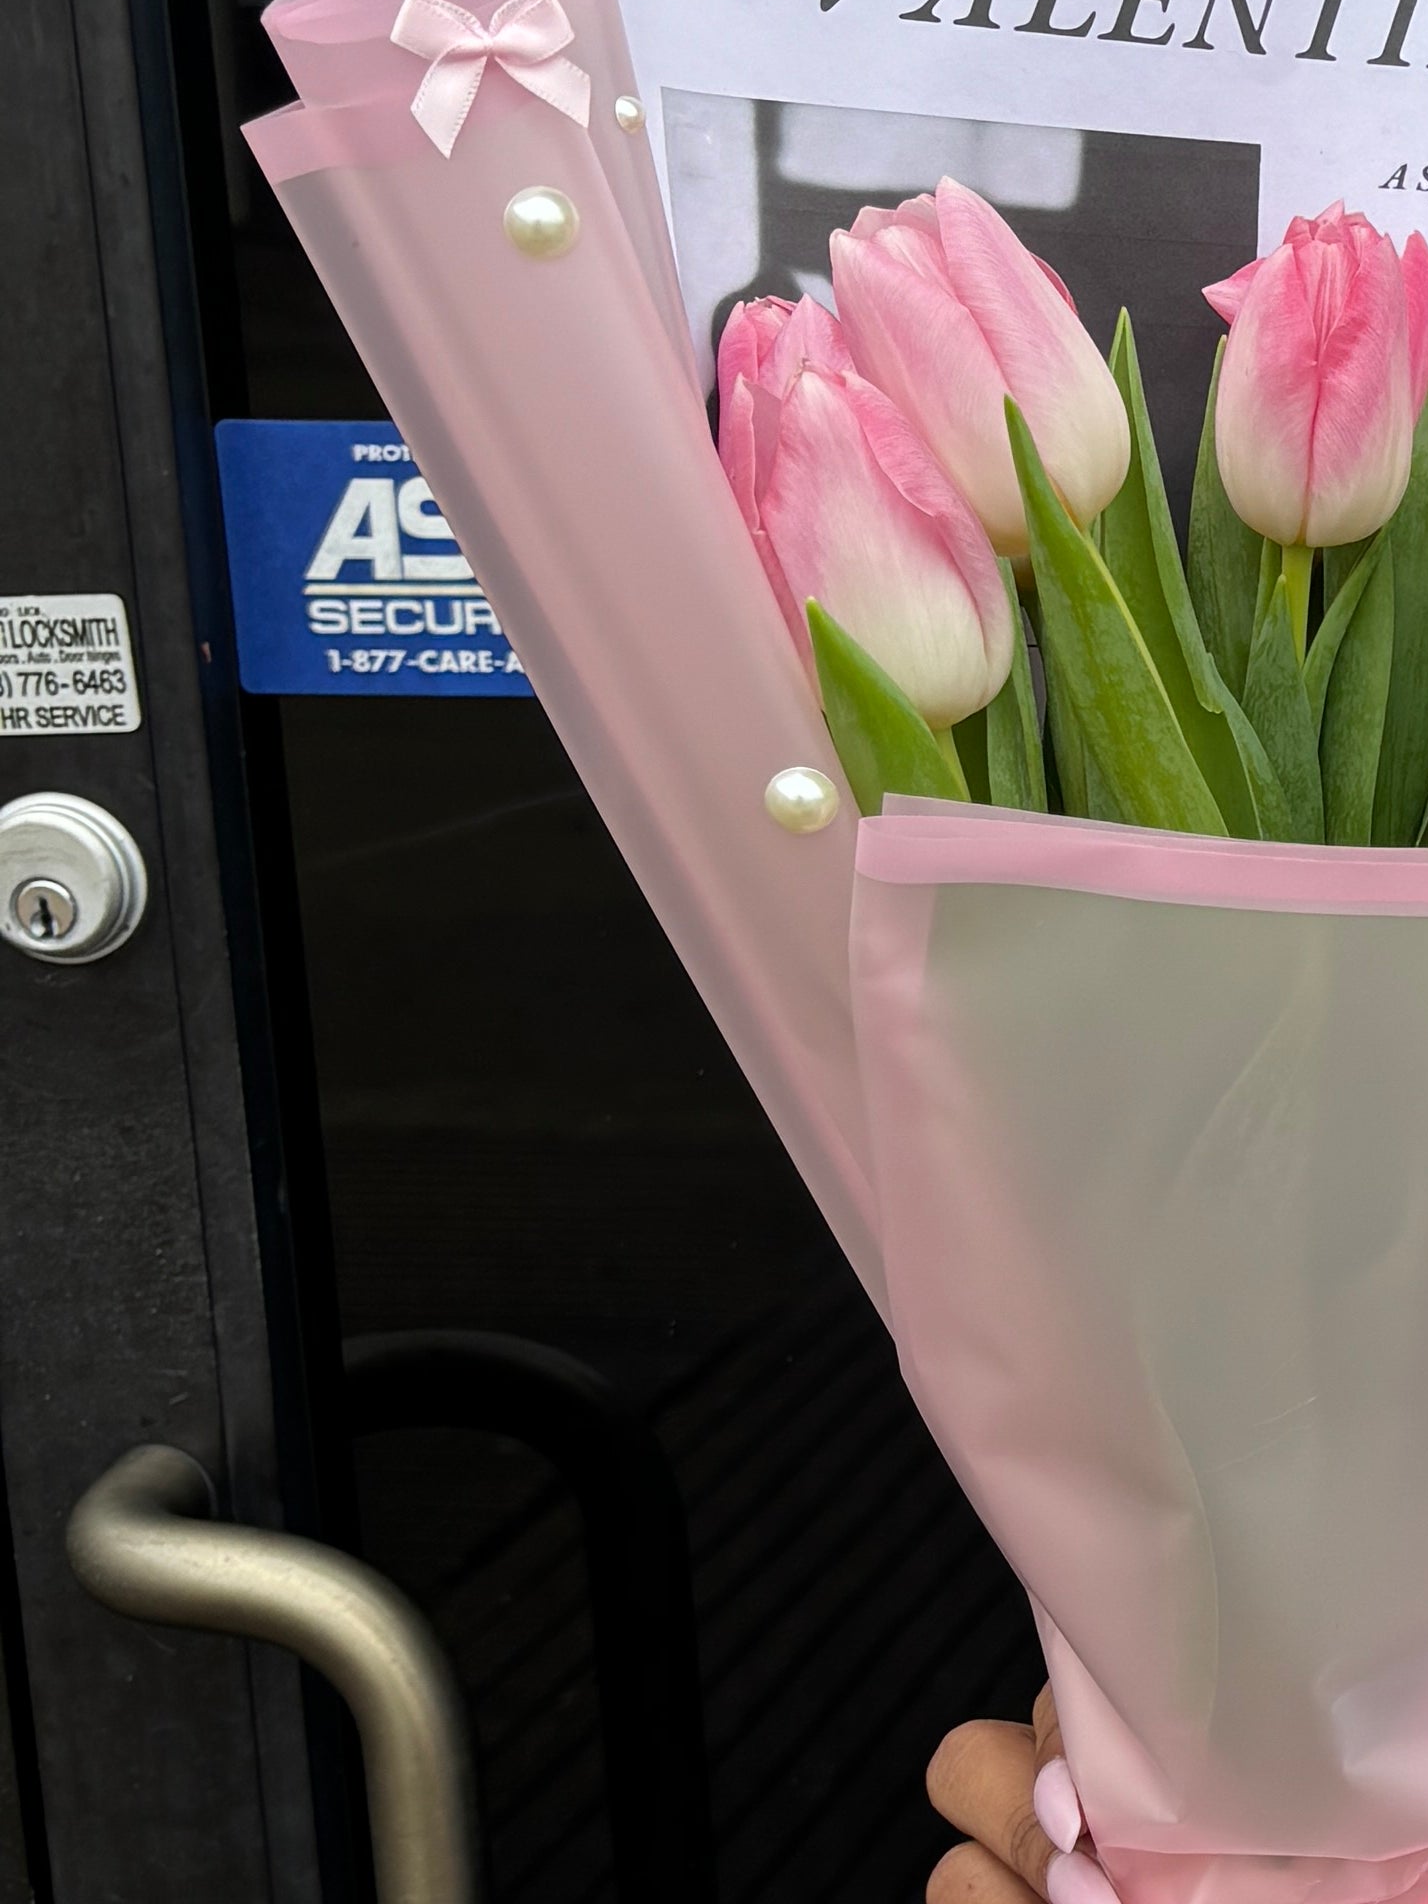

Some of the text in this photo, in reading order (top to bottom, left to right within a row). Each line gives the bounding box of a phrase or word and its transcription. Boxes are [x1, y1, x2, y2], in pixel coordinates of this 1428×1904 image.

[1378, 163, 1408, 190] A
[304, 476, 475, 581] AS
[308, 598, 502, 636] SECUR
[9, 617, 120, 649] LOCKSMITH
[327, 648, 525, 674] 1-877-CARE-A
[1, 704, 127, 730] HR SERVICE
